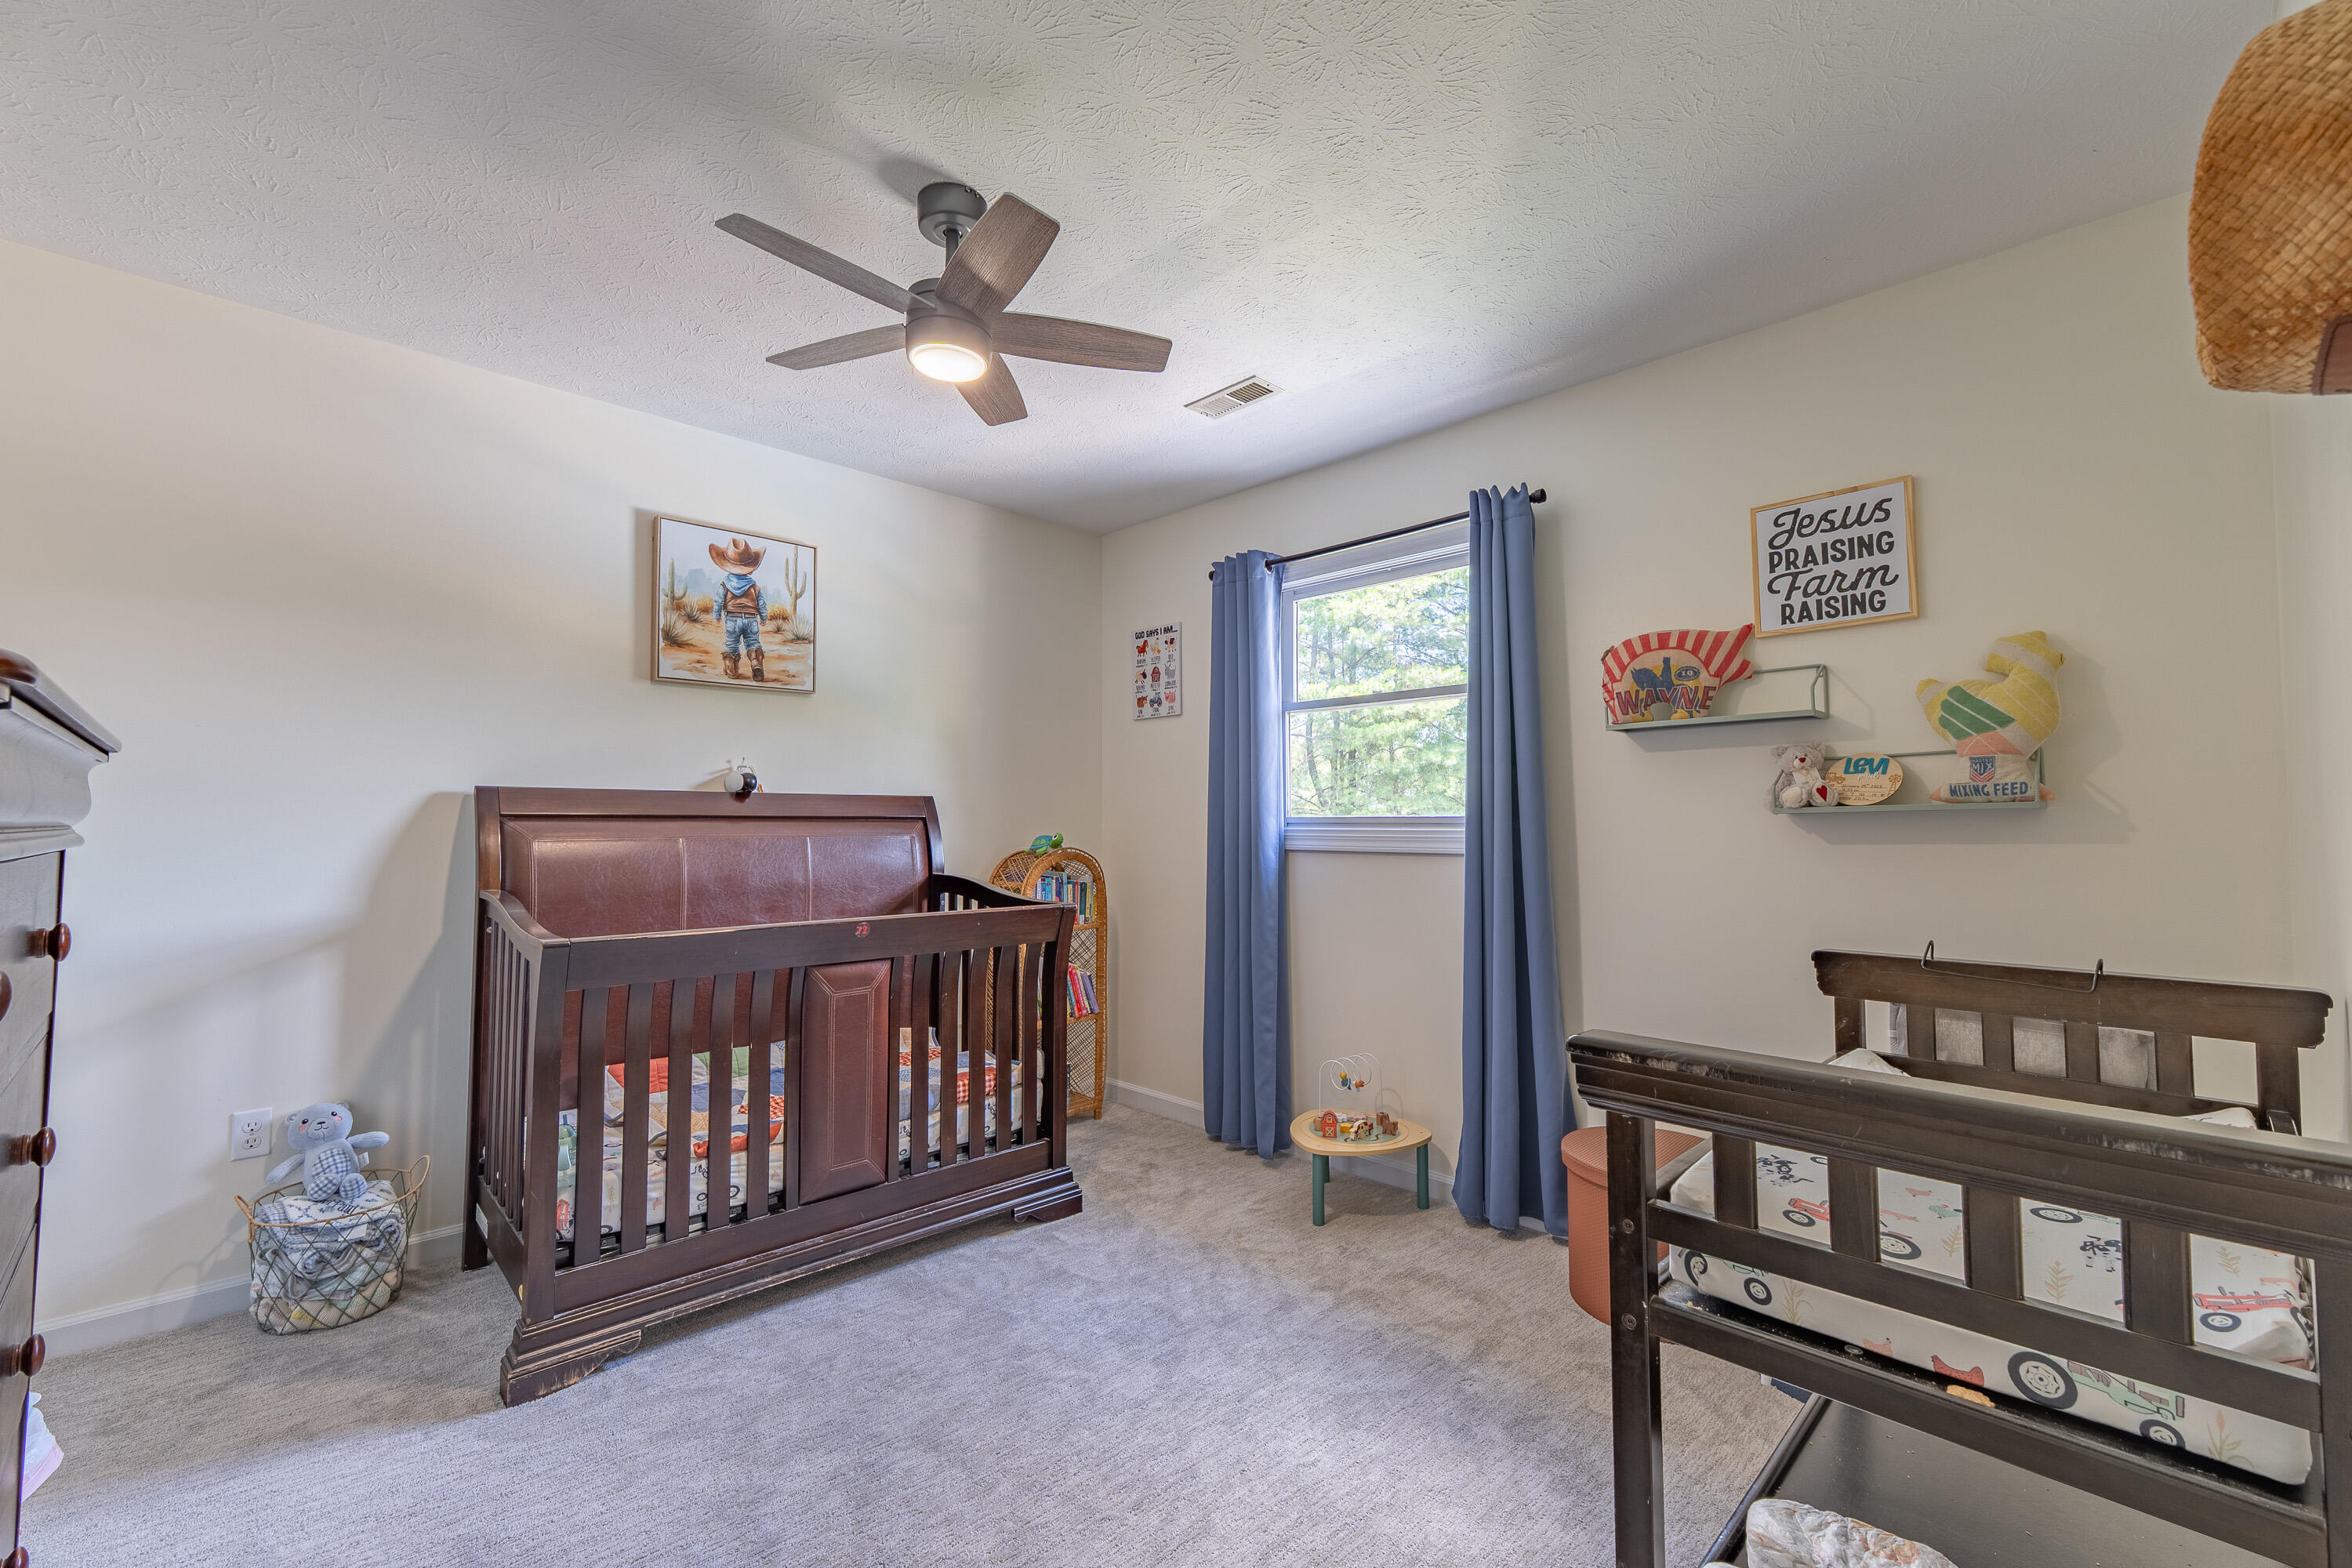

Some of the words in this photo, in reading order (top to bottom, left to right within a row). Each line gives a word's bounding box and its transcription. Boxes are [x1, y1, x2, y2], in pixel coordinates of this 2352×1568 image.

[1768, 497, 1893, 550] Jesus
[1769, 531, 1895, 574] PRAISING
[1767, 564, 1900, 601] Farm
[1780, 590, 1886, 625] RAISING
[1135, 630, 1145, 640] GOD
[1145, 628, 1160, 638] SAYS
[1615, 685, 1717, 716] WAYNE
[1972, 762, 1993, 774] MIX
[1949, 784, 1990, 797] MIXING
[1993, 782, 2029, 796] FEED
[332, 1200, 359, 1215] Paul
